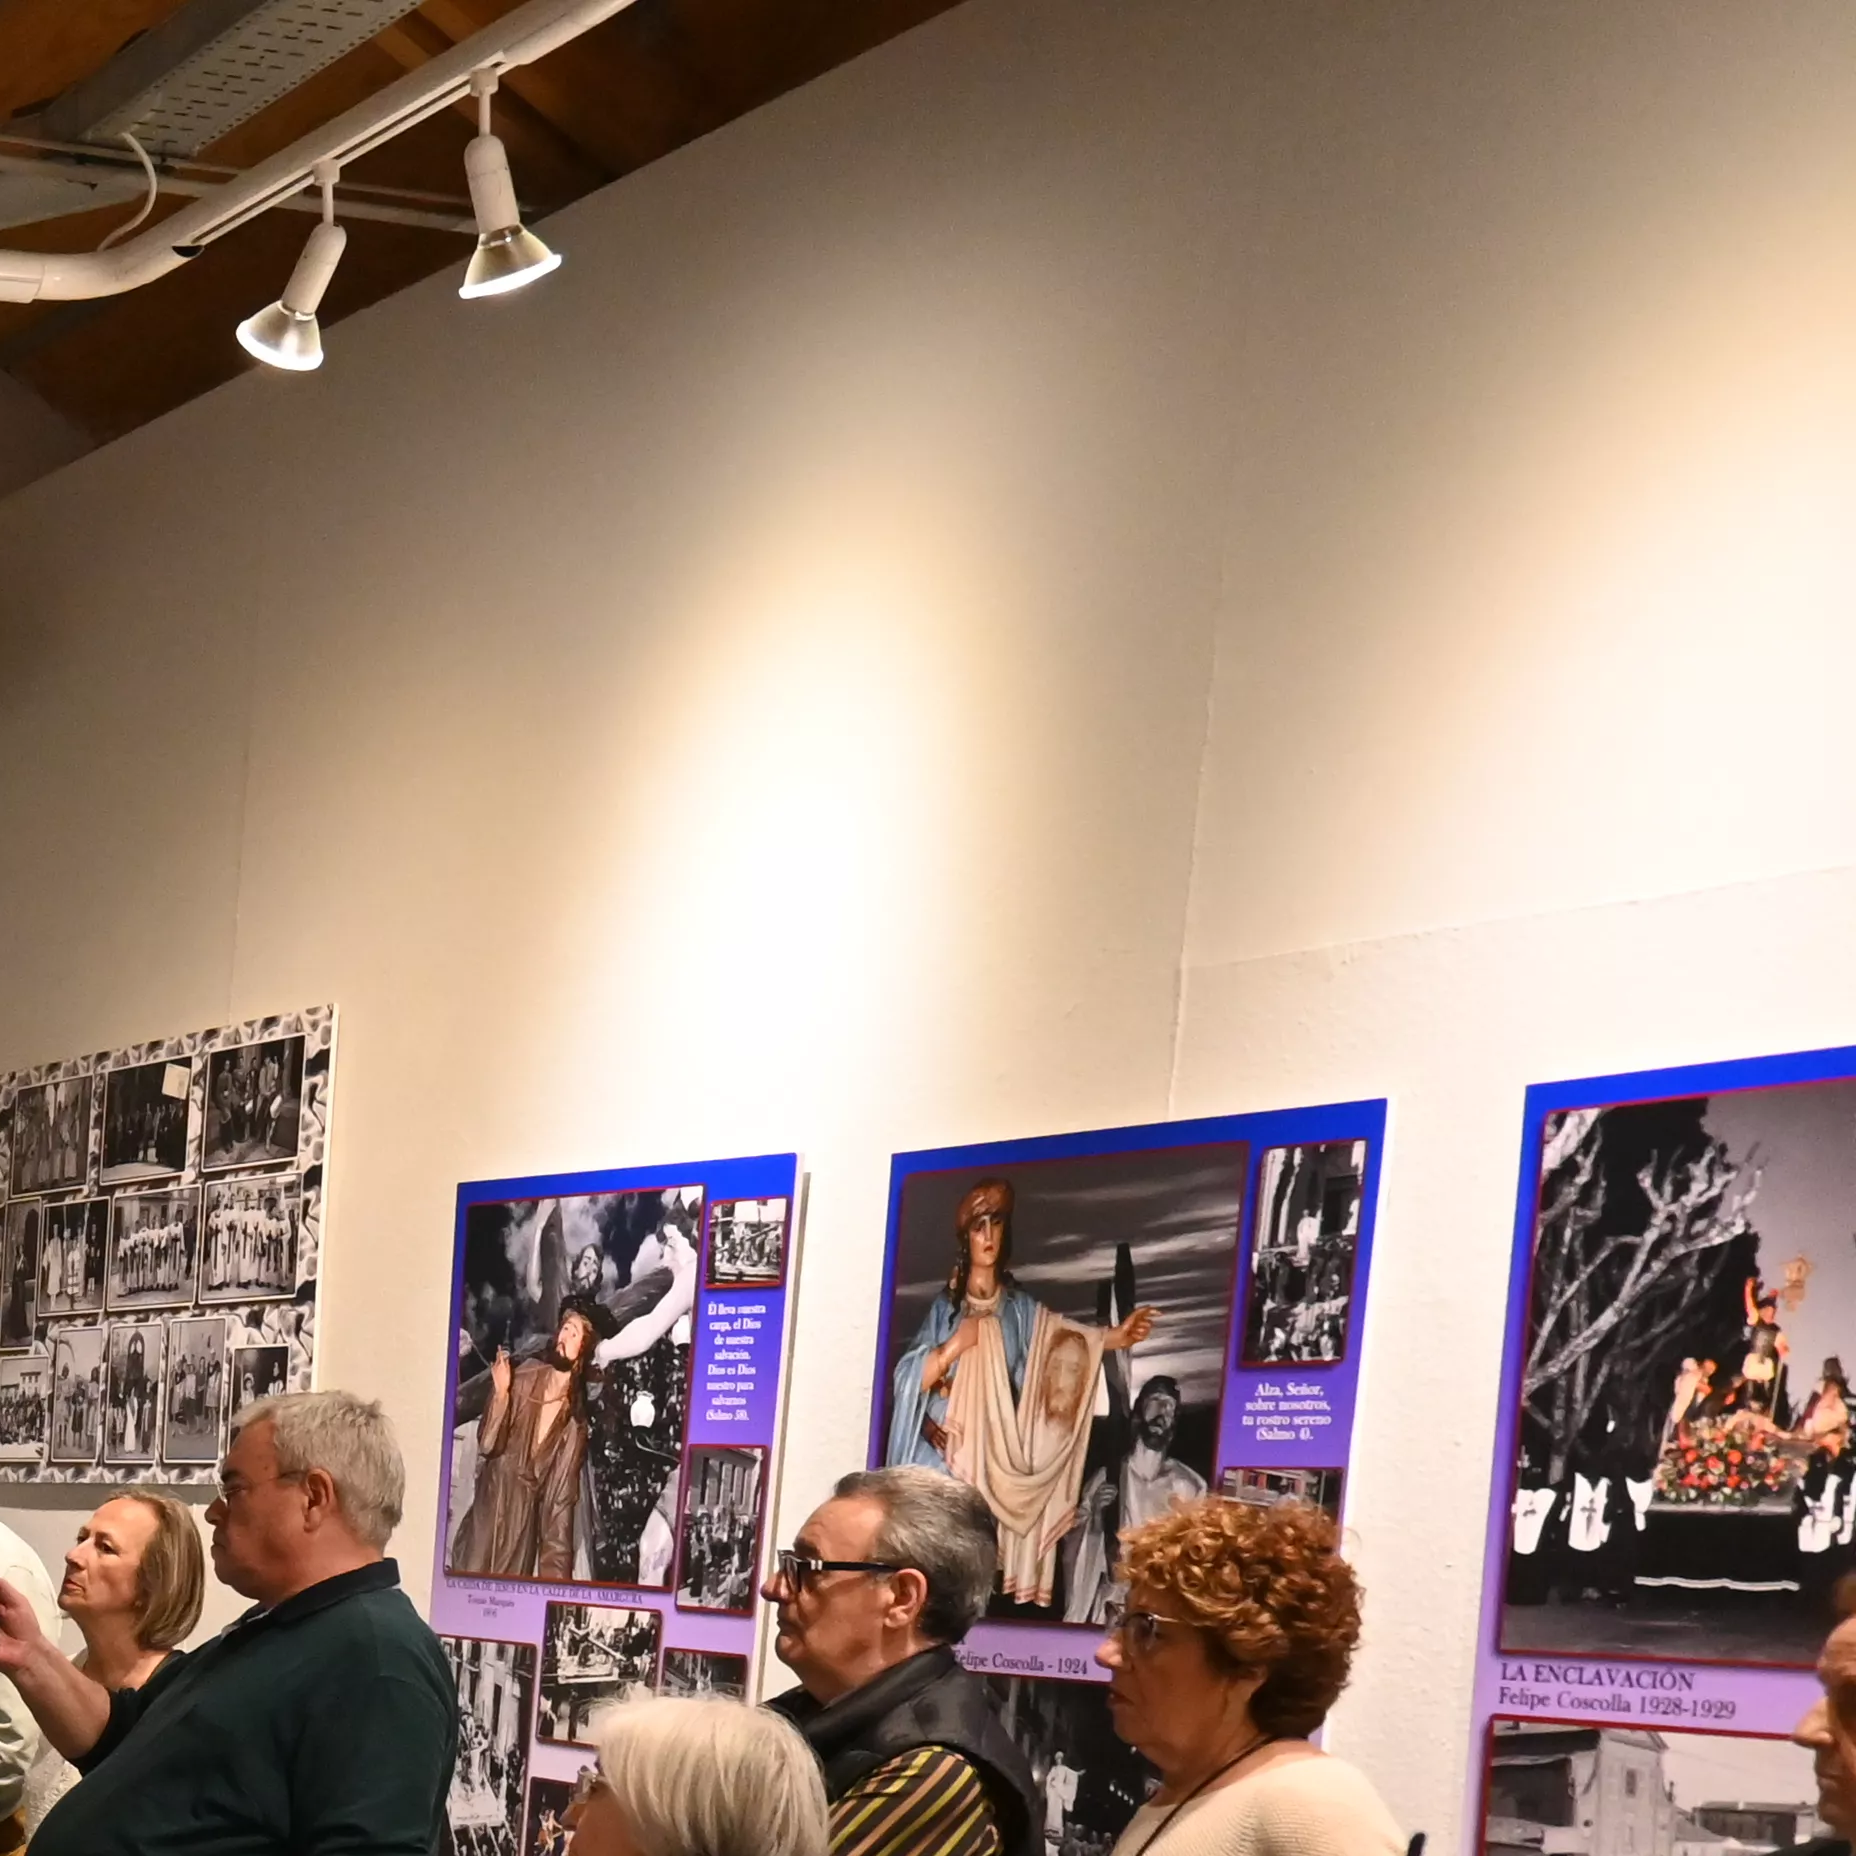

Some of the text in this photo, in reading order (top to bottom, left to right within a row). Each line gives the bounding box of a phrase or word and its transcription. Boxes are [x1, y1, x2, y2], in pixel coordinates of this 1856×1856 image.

[1286, 1382, 1324, 1397] Señor,
[1245, 1398, 1331, 1411] sobre nosotros,
[1256, 1415, 1290, 1425] rostro
[1292, 1415, 1332, 1425] sereno
[992, 1653, 1044, 1671] Coscolla
[1057, 1657, 1088, 1675] 1924
[1501, 1662, 1696, 1691] LA ENCLAVACIÓN
[1499, 1686, 1736, 1719] Felipe Coscolla 1928-1929
